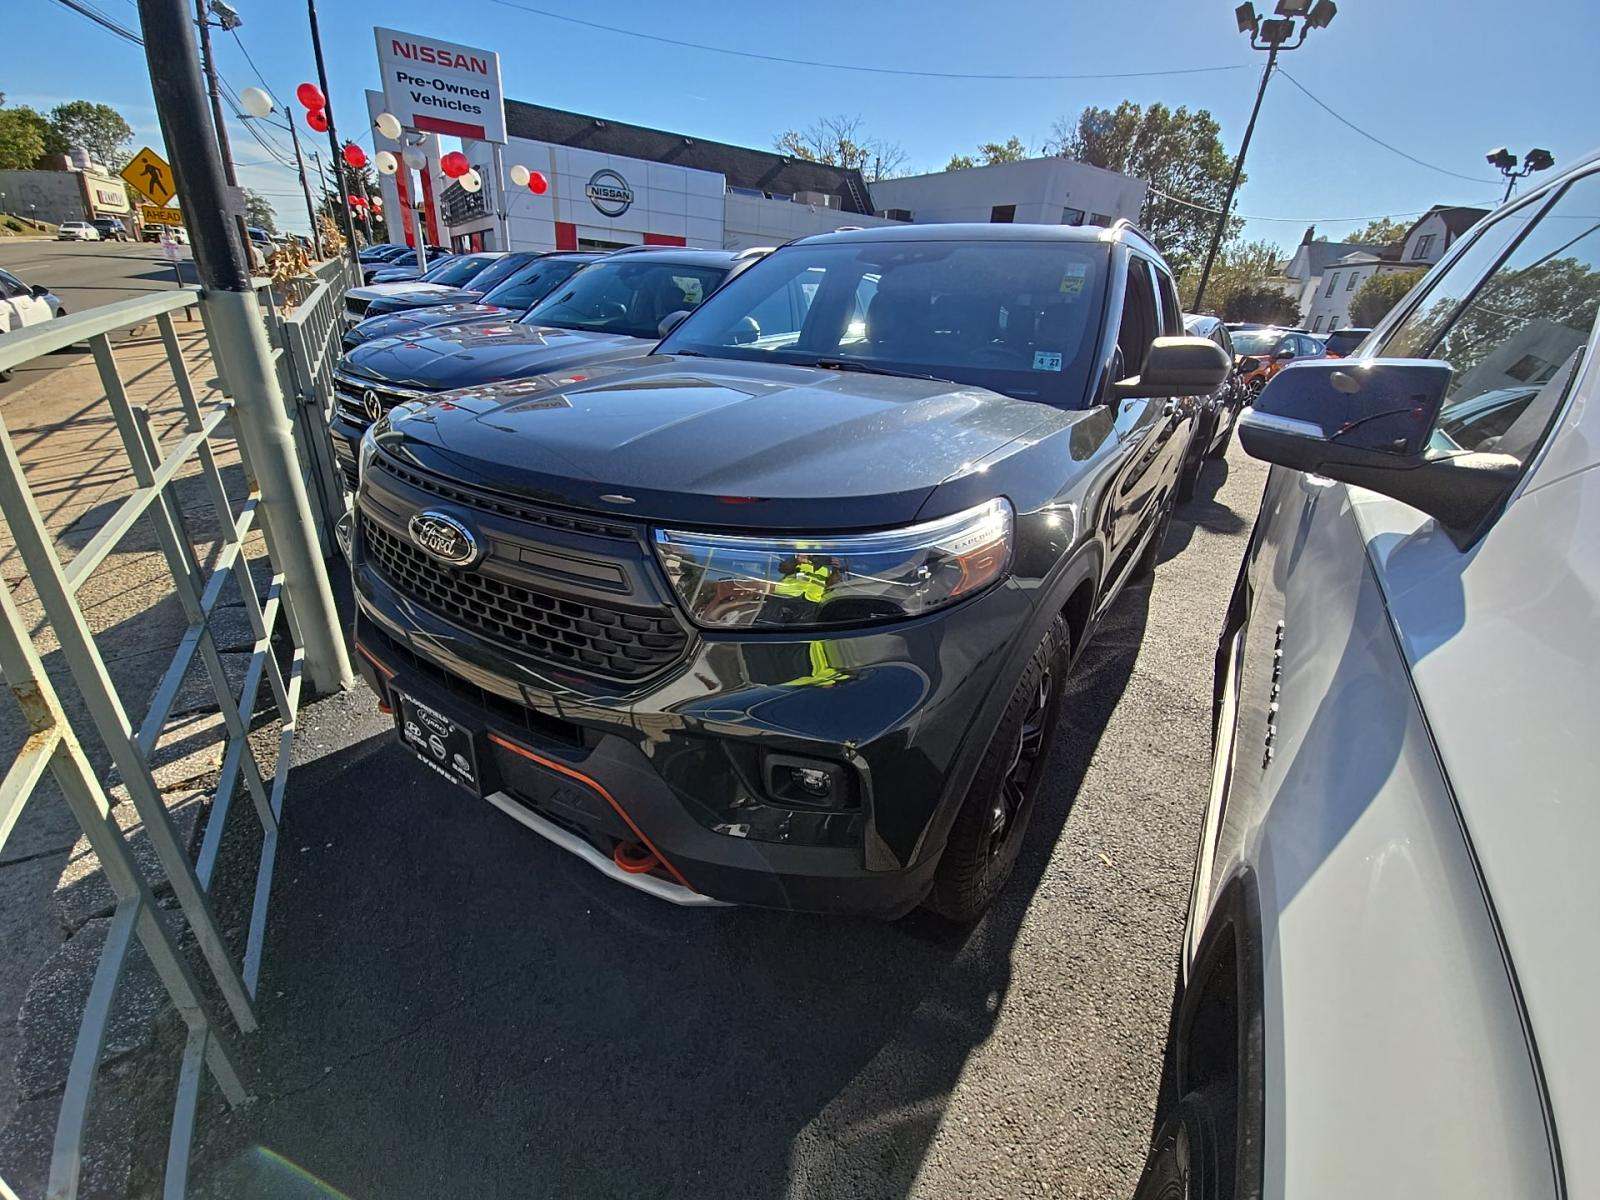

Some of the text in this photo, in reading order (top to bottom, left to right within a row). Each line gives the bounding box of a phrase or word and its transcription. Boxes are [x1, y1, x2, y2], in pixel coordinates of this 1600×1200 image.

[392, 39, 488, 75] NISSAN
[396, 71, 490, 100] Pre-Owned
[409, 91, 482, 114] Vehicles
[591, 187, 630, 199] NISSAN
[146, 210, 181, 222] AHEAD
[417, 520, 457, 555] Ford
